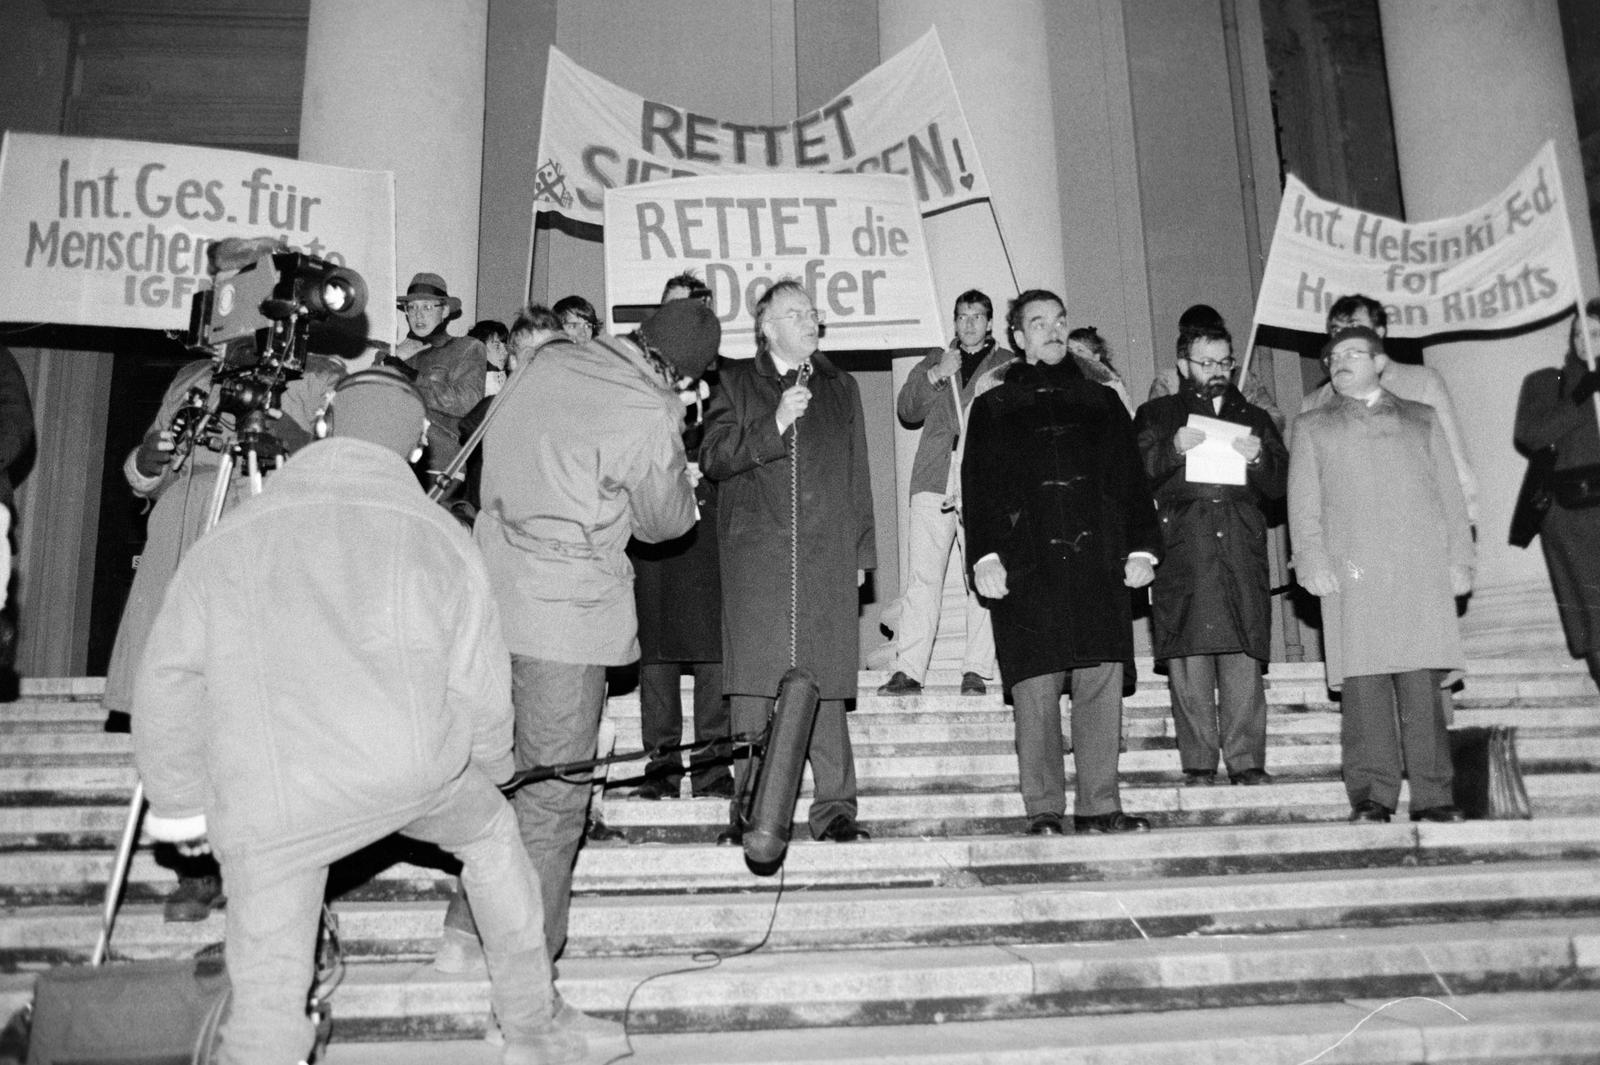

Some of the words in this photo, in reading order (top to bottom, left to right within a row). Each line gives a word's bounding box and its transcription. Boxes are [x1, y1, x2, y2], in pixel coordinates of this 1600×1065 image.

[642, 96, 856, 168] RETTET
[58, 158, 132, 219] Int.
[135, 163, 237, 223] Ges.
[242, 168, 321, 232] für
[636, 198, 836, 260] RETTET
[852, 206, 909, 257] die
[1293, 194, 1344, 249] Int.
[1353, 214, 1495, 265] Helsinki
[706, 259, 886, 323] Döfer
[1296, 272, 1428, 326] Han
[1442, 263, 1558, 323] Rights
[1384, 264, 1448, 295] for
